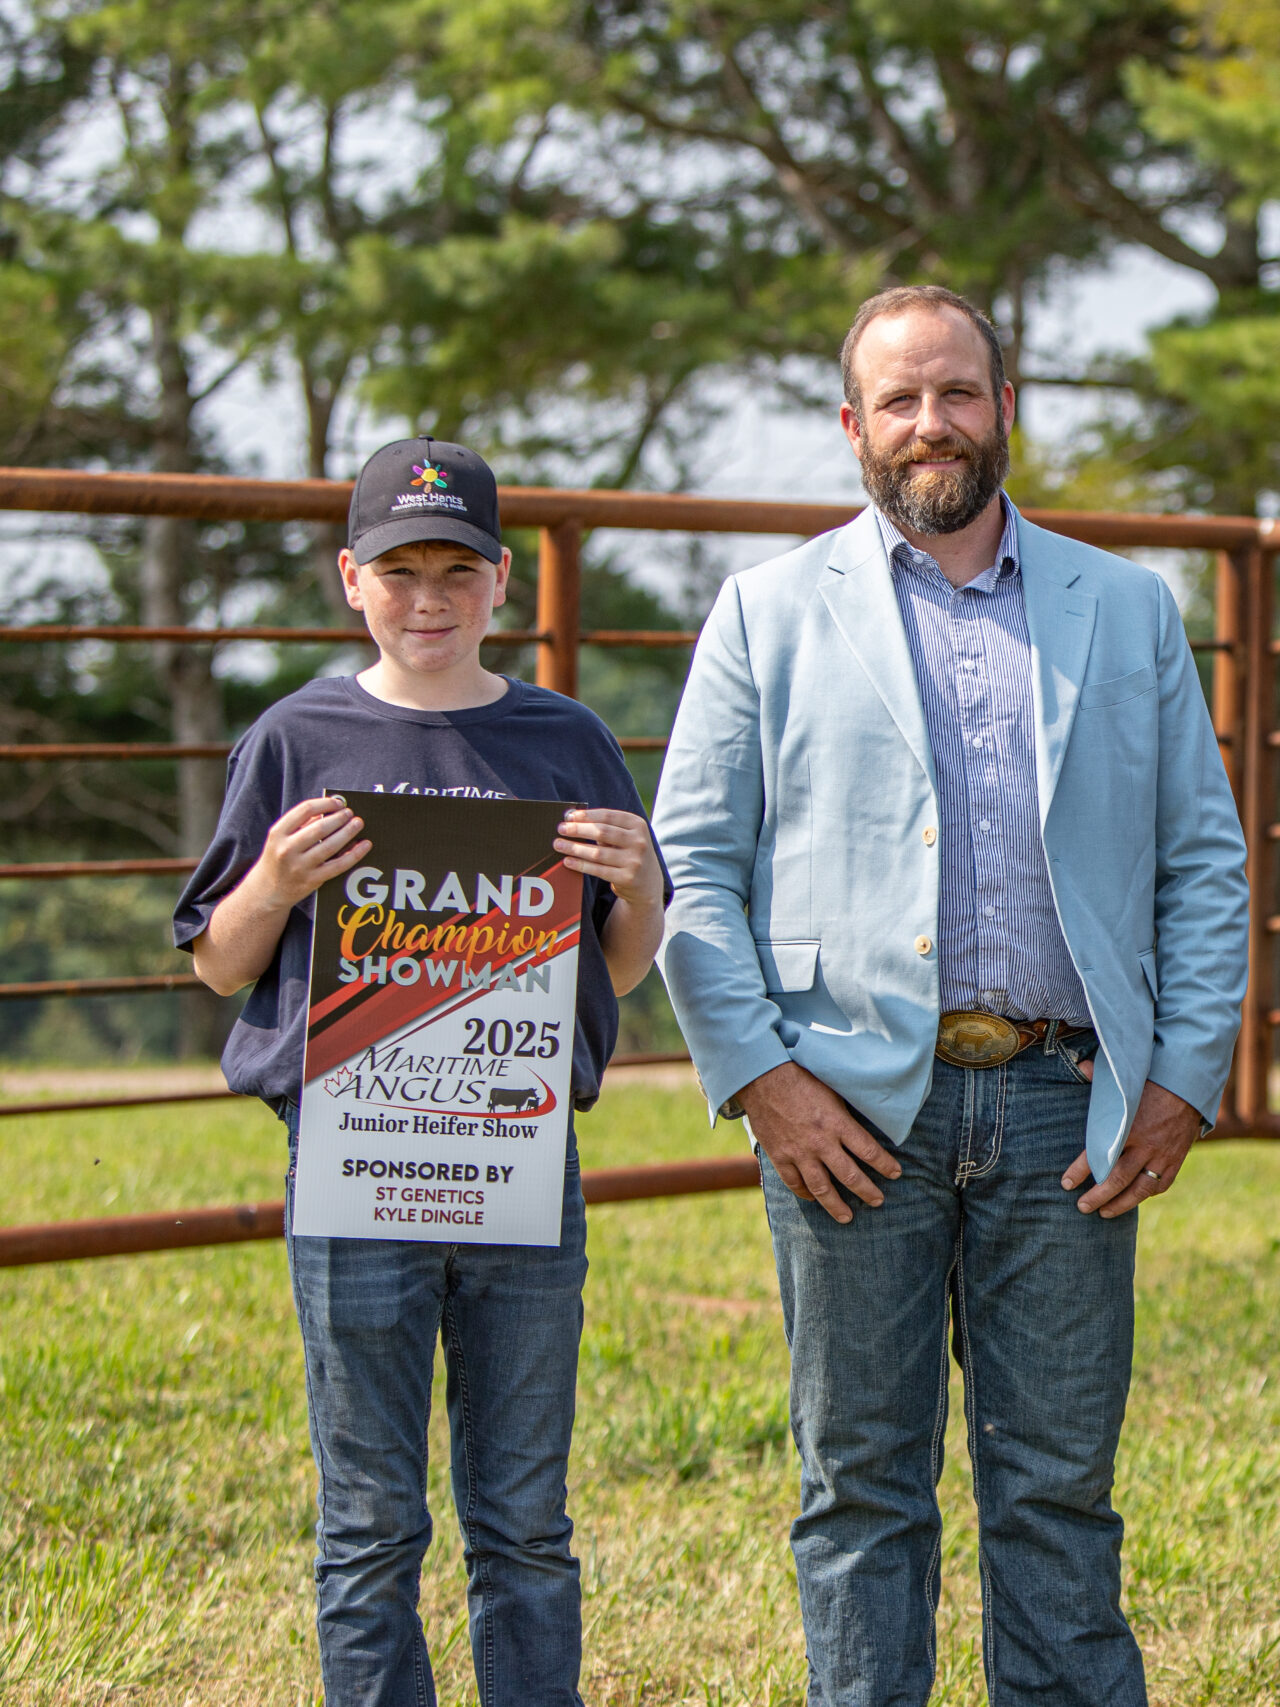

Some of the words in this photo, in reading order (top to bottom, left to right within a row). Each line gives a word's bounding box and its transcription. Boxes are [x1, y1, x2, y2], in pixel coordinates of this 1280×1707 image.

[397, 493, 428, 505] West
[430, 493, 464, 505] Hants
[345, 866, 555, 917] GRAND
[336, 902, 564, 974] Champion
[337, 956, 551, 994] SHOWMAN
[462, 1017, 561, 1059] 2025
[354, 1046, 513, 1077] MARITIME
[334, 1075, 487, 1104] ANGUS
[338, 1112, 409, 1134] Junior
[411, 1115, 479, 1137] Heifer
[482, 1118, 539, 1139] Show
[342, 1159, 480, 1182] SPONSORED
[486, 1164, 514, 1183] BY
[375, 1186, 398, 1202] ST
[400, 1187, 485, 1204] GENETICS
[373, 1207, 418, 1223] KYLE
[421, 1208, 484, 1225] DINGLE
